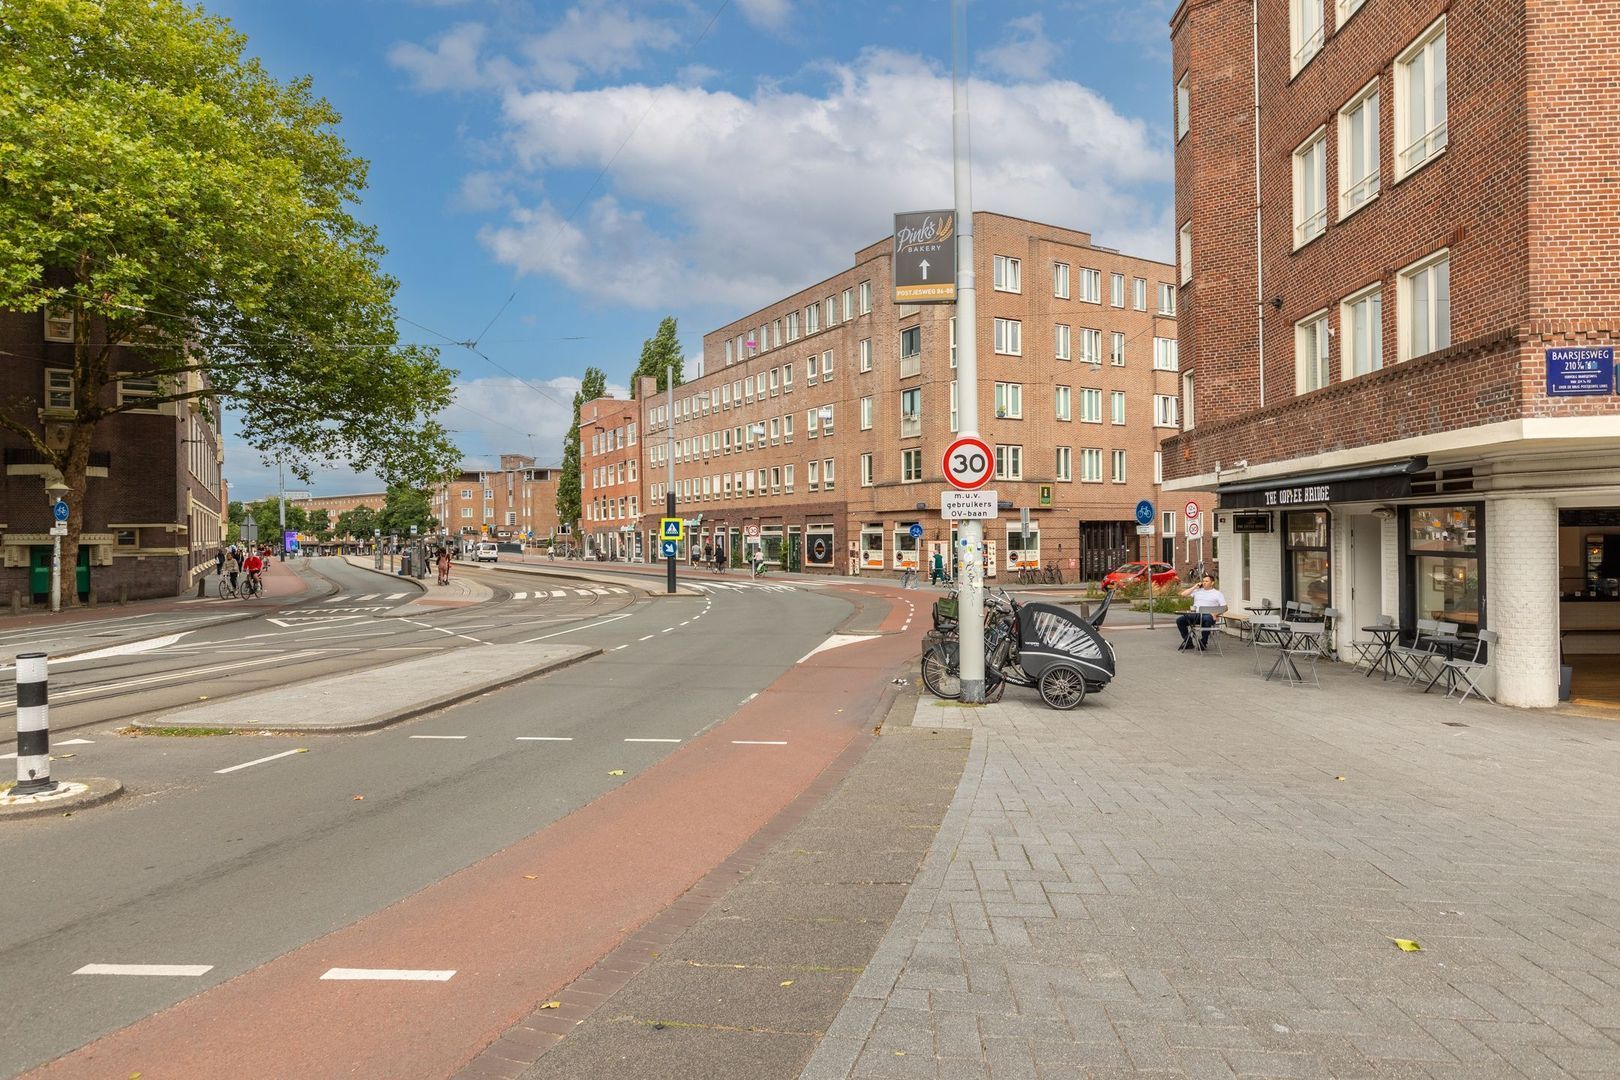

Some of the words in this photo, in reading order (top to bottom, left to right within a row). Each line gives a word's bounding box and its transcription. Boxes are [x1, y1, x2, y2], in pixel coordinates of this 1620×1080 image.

[897, 216, 936, 253] Pink's
[907, 245, 941, 253] BAKERY
[896, 287, 936, 296] POSTJESWEG
[1552, 350, 1609, 361] BAARSJESWEG
[1565, 361, 1577, 370] 210
[953, 454, 986, 473] 30
[1265, 491, 1277, 505] THE
[1279, 488, 1303, 504] COFFEE
[1304, 485, 1330, 502] BRIDGE
[947, 502, 992, 510] gebruikers
